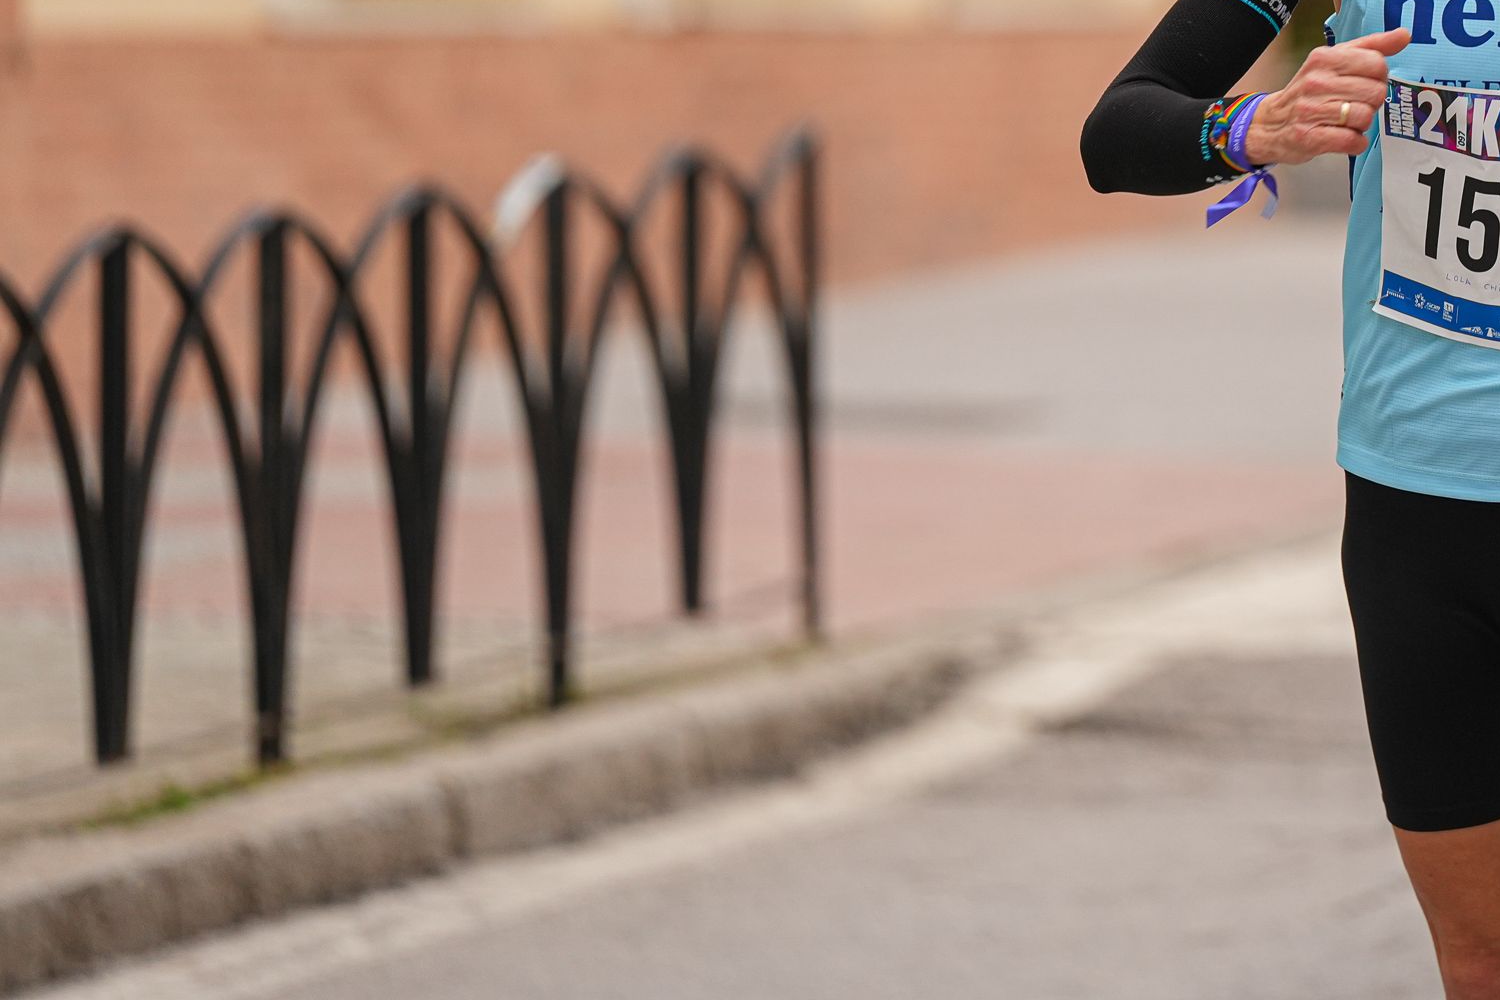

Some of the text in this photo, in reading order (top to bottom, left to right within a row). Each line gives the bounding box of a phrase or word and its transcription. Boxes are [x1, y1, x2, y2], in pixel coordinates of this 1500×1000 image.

[1389, 103, 1402, 134] MEDIA
[1457, 131, 1466, 146] 097
[1445, 273, 1472, 286] LOLA
